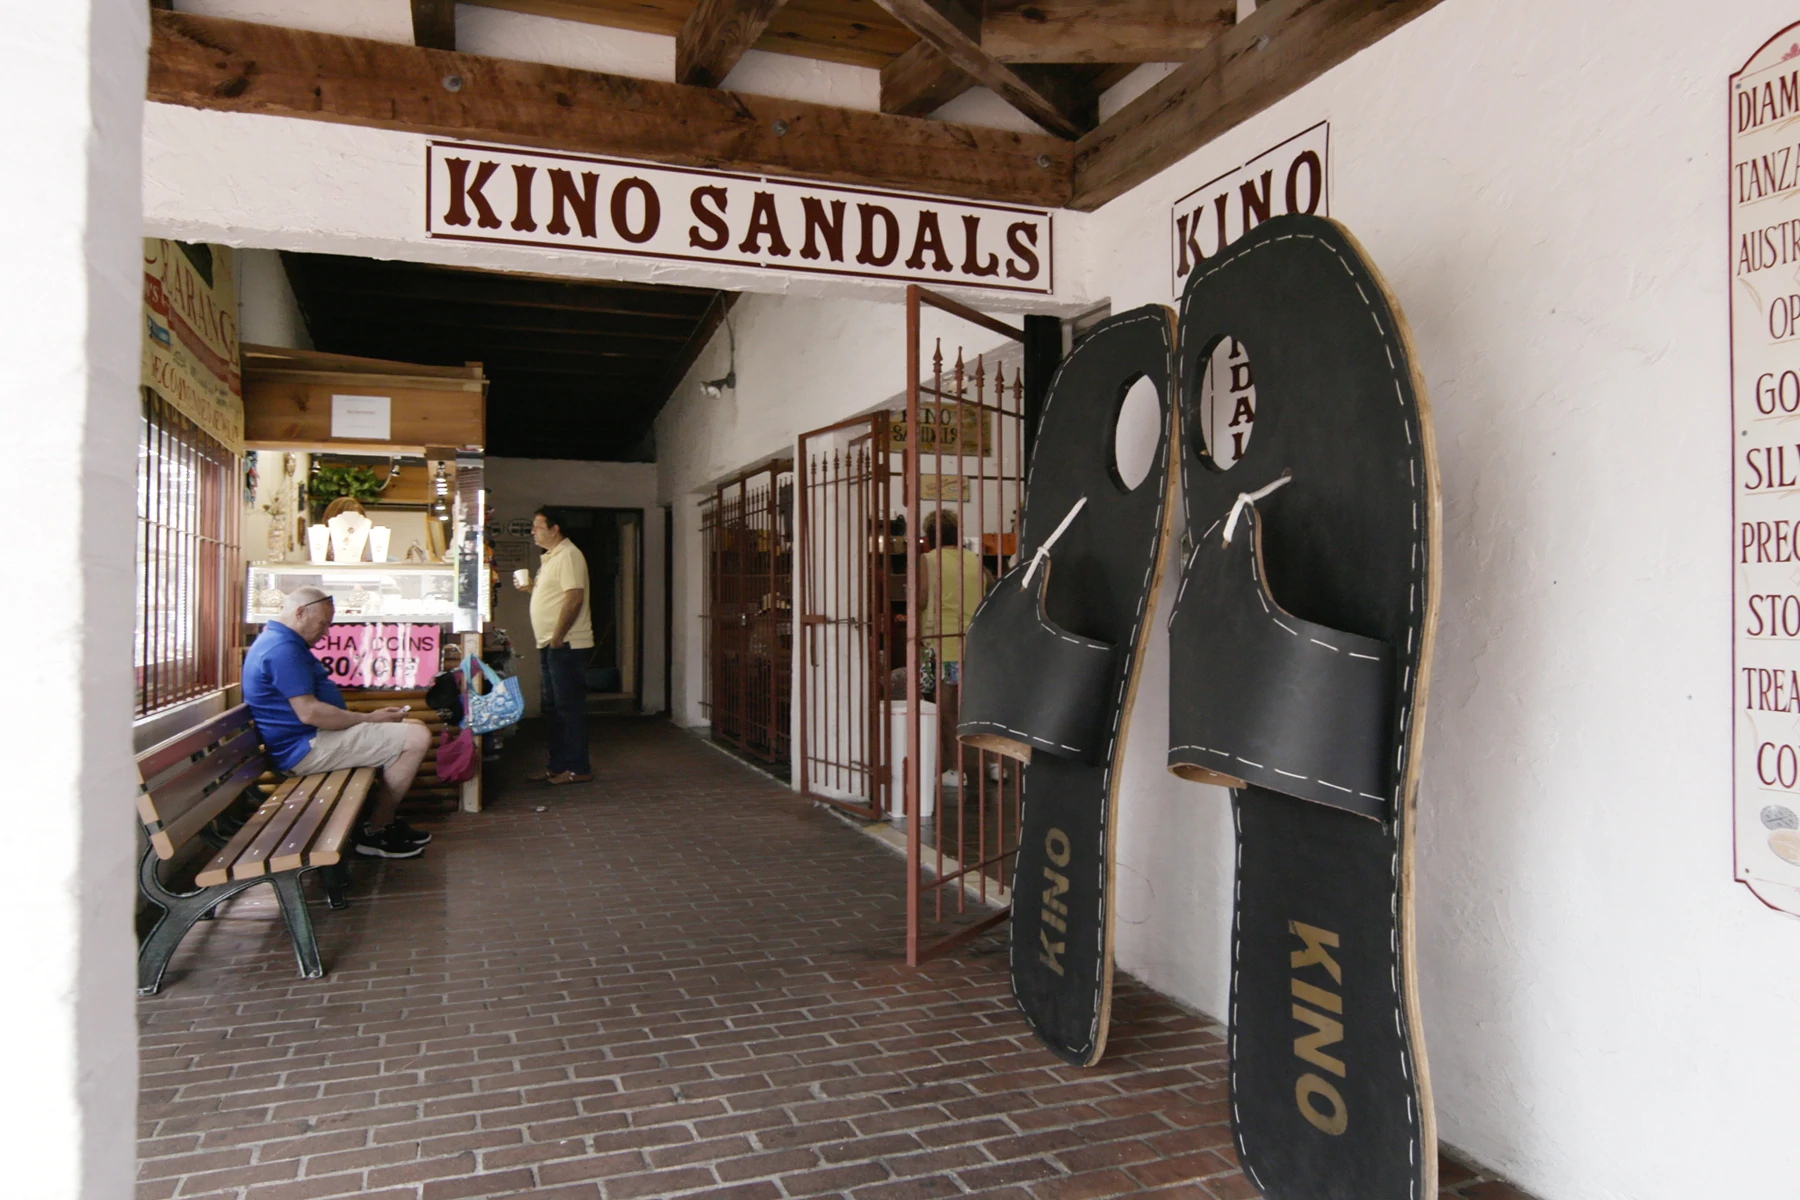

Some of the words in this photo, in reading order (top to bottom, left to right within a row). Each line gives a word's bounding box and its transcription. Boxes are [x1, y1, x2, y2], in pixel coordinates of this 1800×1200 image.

[443, 156, 661, 244] KINO
[688, 183, 1039, 282] SANDALS
[1176, 150, 1322, 278] KINO
[901, 408, 951, 425] NO
[372, 635, 434, 651] COINS
[1039, 827, 1071, 976] KINO
[1288, 919, 1349, 1136] KINO
